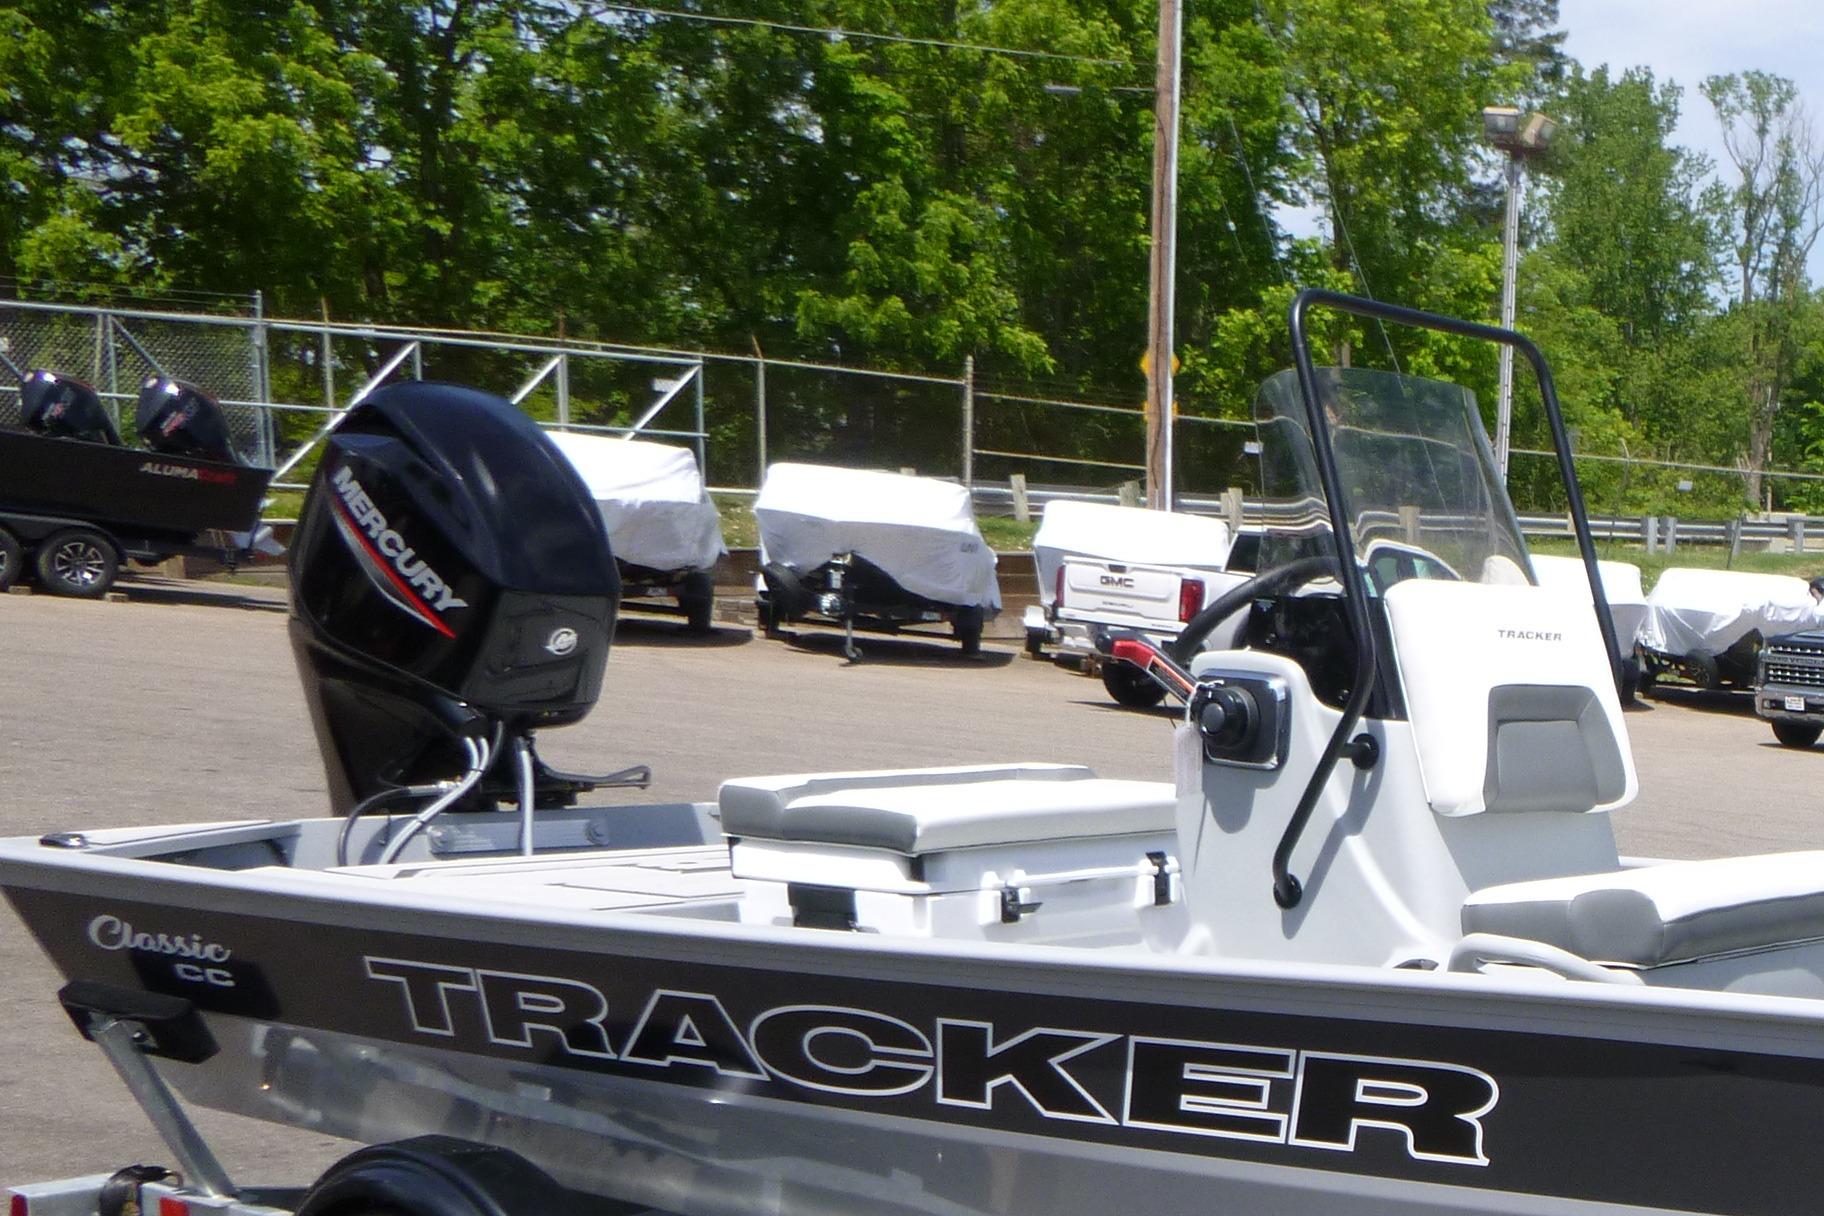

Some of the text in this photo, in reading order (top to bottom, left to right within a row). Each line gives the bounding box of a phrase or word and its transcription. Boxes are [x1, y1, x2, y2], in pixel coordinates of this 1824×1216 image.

[332, 465, 469, 612] MERCURY
[1100, 575, 1134, 588] GMC
[1498, 629, 1562, 641] TRACKER
[88, 914, 232, 963] Classic
[175, 963, 236, 987] CC
[365, 956, 1499, 1167] TRACKER
